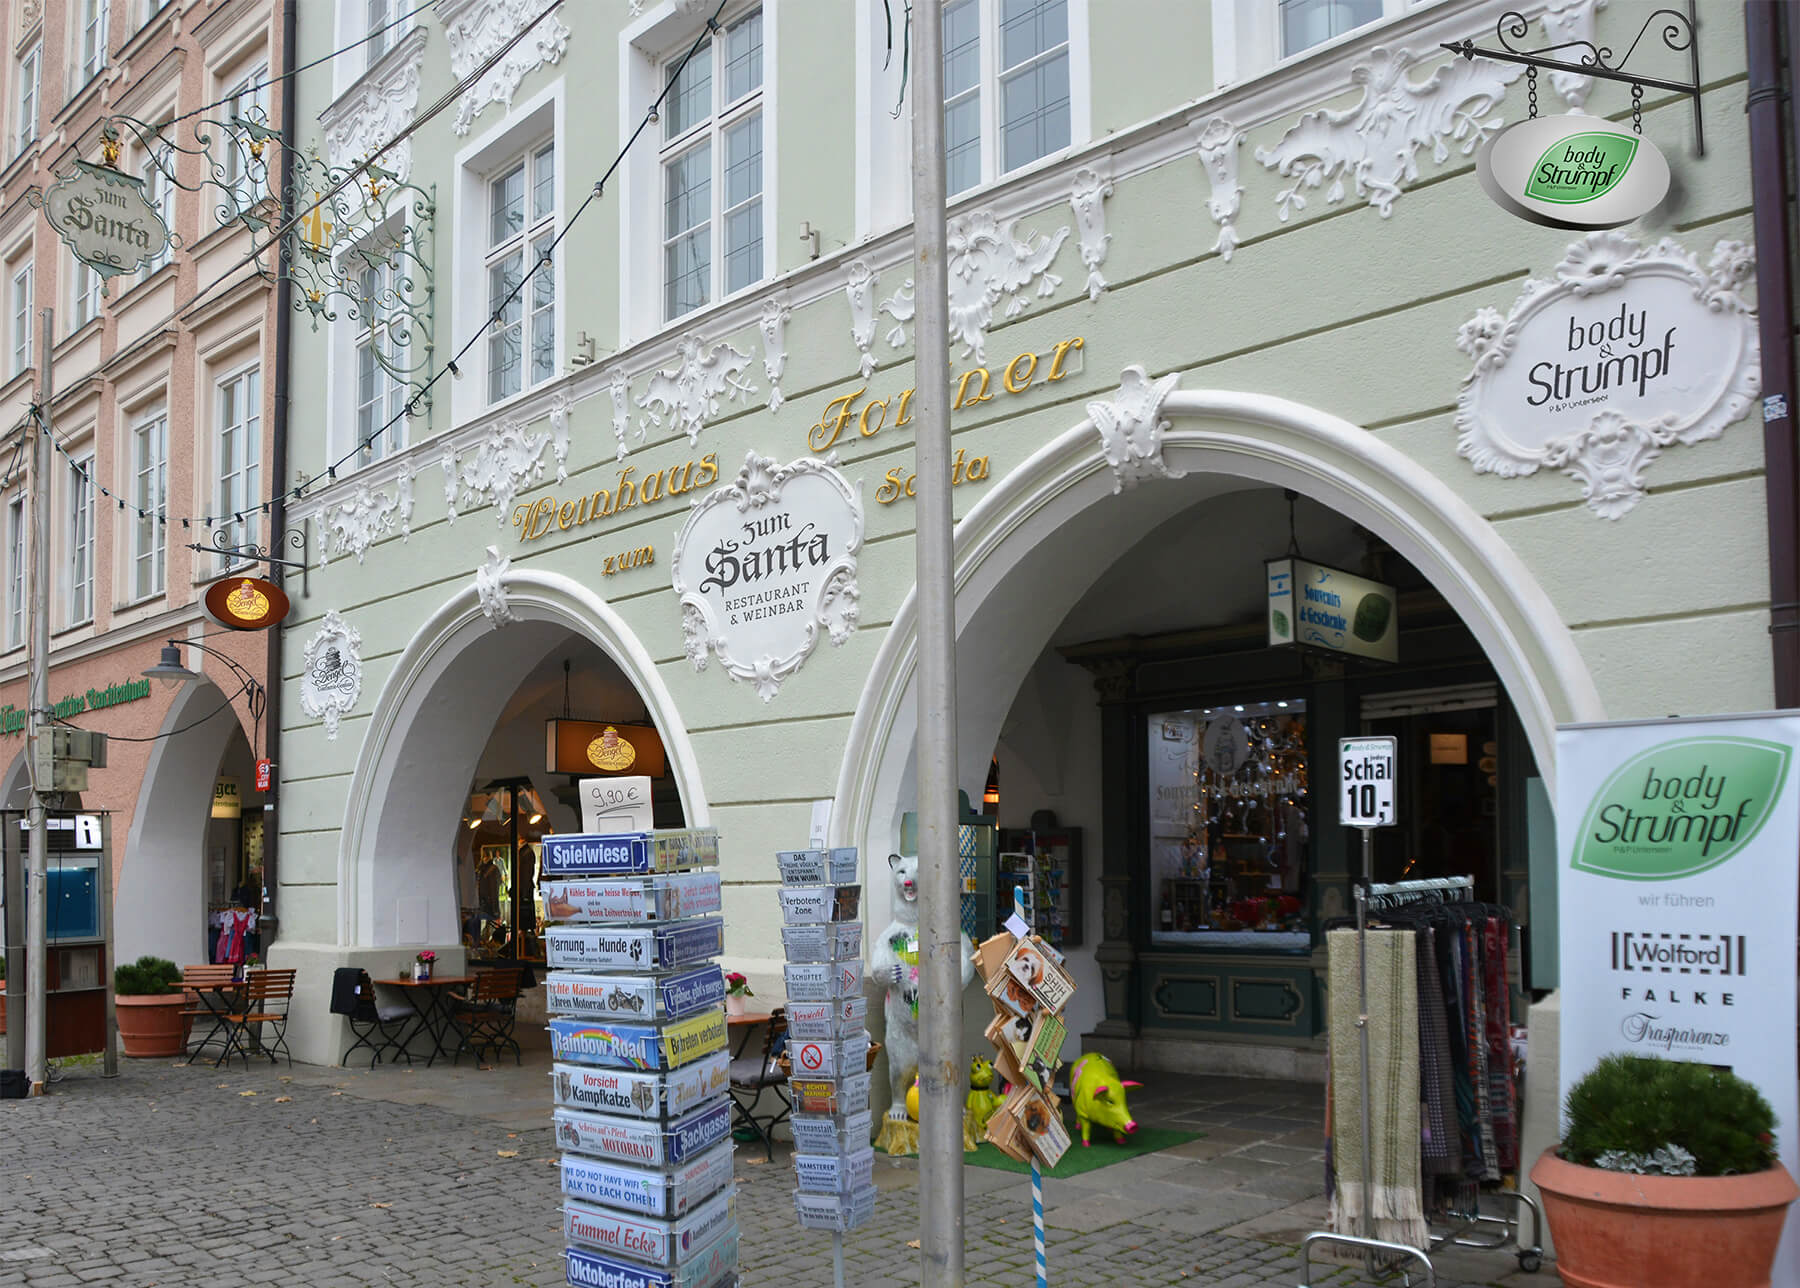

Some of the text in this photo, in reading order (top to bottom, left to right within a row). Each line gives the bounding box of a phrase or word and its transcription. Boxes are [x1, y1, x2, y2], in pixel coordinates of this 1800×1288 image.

[1564, 146, 1606, 169] body
[1537, 162, 1619, 193] Strumpf
[95, 187, 127, 209] zum
[63, 193, 150, 250] Santa
[1568, 302, 1647, 352] body
[1599, 343, 1615, 358] &
[1527, 327, 1677, 407] Strumpf
[512, 336, 1085, 543] Weinhaus Forner
[601, 448, 990, 576] zum Sta
[741, 512, 793, 545] zum
[699, 522, 831, 597] Santa
[725, 582, 810, 612] RESTAURANT
[730, 600, 805, 625] & WEINBAR
[1344, 757, 1391, 781] Schal
[592, 786, 640, 808] 9,90 €
[1642, 765, 1726, 810] body
[1347, 784, 1390, 822] 10,-
[1671, 800, 1686, 813] &
[1595, 799, 1752, 857] Strumpf
[553, 844, 629, 868] Spielwiese
[793, 853, 806, 861] DAS
[587, 887, 597, 897] Bier
[785, 896, 821, 906] Verbotene
[1638, 895, 1659, 907] wir
[794, 906, 813, 915] Zone
[599, 936, 627, 953] Hunde
[1633, 942, 1720, 965] Wolford
[572, 983, 603, 997] Männer
[1040, 979, 1062, 1004] TZU
[1045, 972, 1067, 997] SHIH
[1622, 987, 1734, 1006] FALKE
[572, 996, 606, 1011] Motorrad
[556, 1031, 647, 1060] Rainbow Road
[583, 1074, 619, 1089] Vorsicht
[572, 1085, 631, 1109] Kampfkatze
[680, 1112, 730, 1151] Sackgasse
[601, 1137, 653, 1160] MOTORRAD
[576, 1168, 586, 1177] DO
[588, 1170, 602, 1181] NOT
[604, 1174, 621, 1187] HAVE
[624, 1178, 640, 1190] WIFI
[567, 1180, 656, 1208] ALK TO EACH OTHER!
[571, 1215, 656, 1254] Fummel Ecke
[571, 1258, 646, 1288] Oktoberfest
